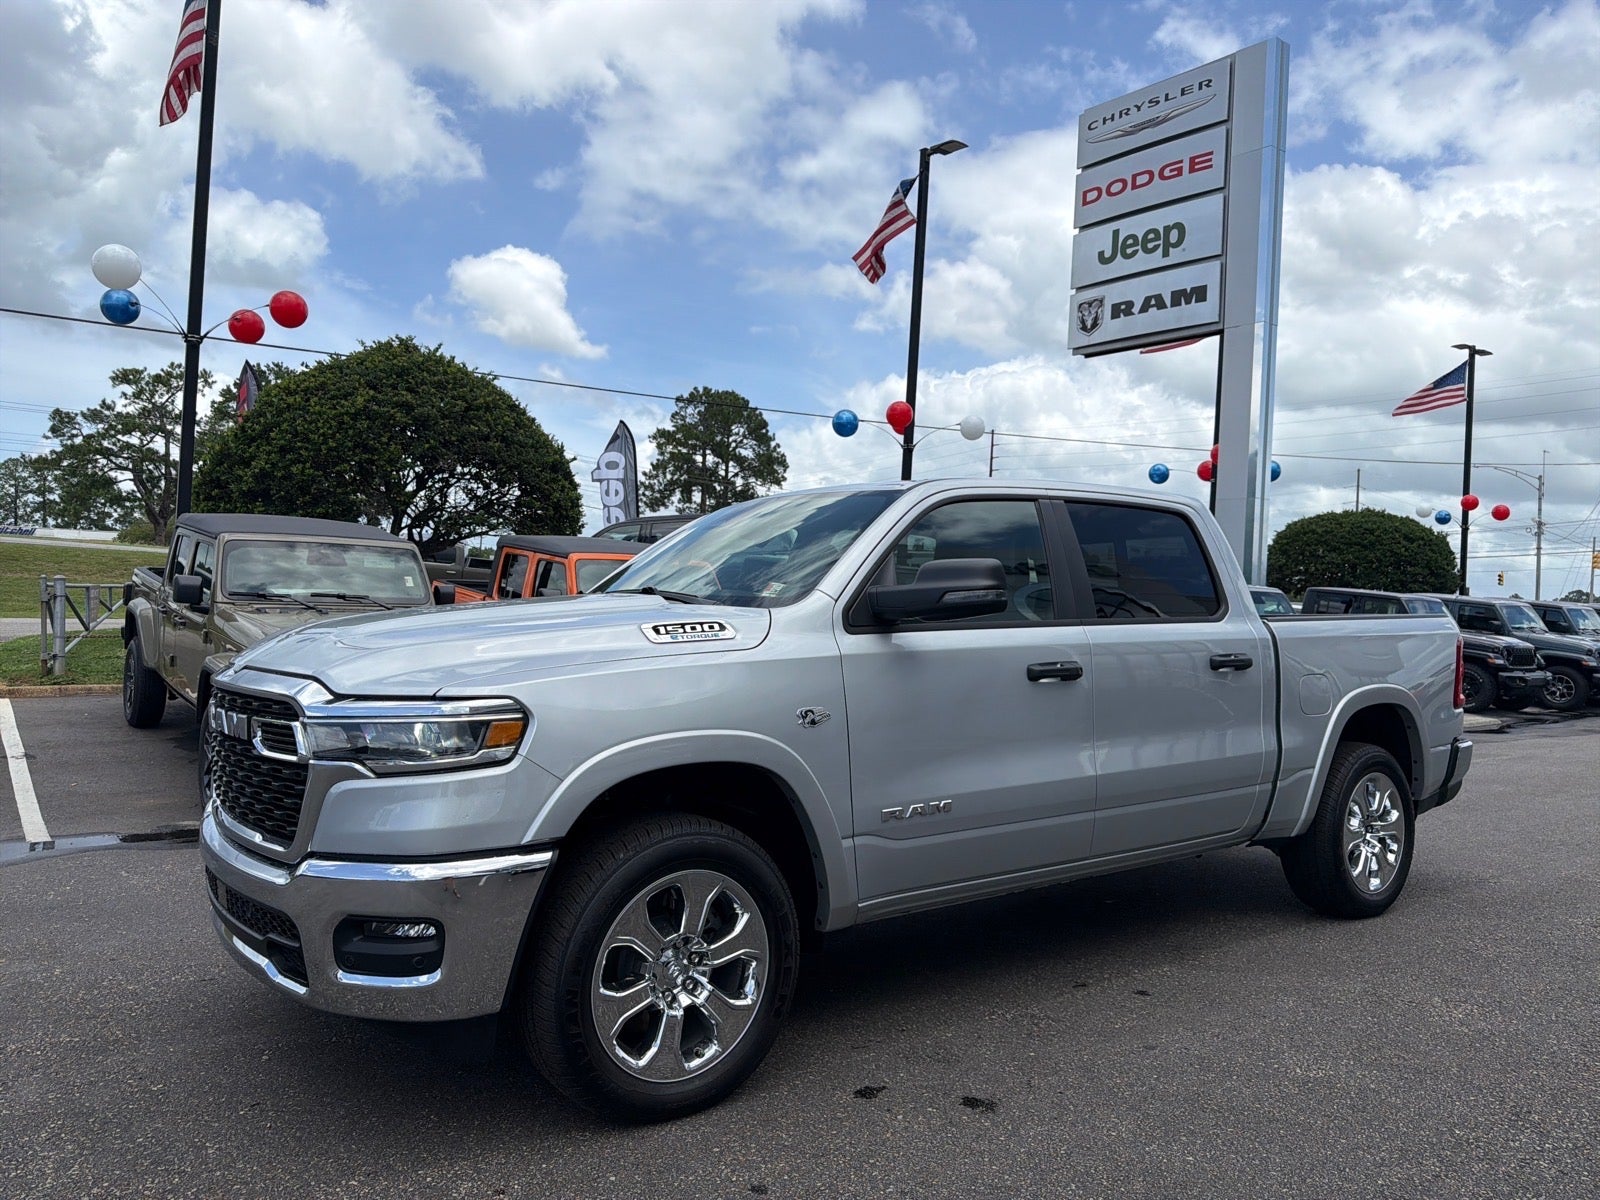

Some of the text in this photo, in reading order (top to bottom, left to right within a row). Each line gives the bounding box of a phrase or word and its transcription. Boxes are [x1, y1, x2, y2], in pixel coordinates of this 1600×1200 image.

[1087, 78, 1213, 131] CHRYSLER
[1081, 150, 1214, 207] DODGE
[1097, 221, 1186, 265] Jeep
[1110, 284, 1208, 320] RAM
[0, 526, 37, 536] itchell
[655, 622, 720, 635] 1500
[881, 799, 952, 823] RAM
